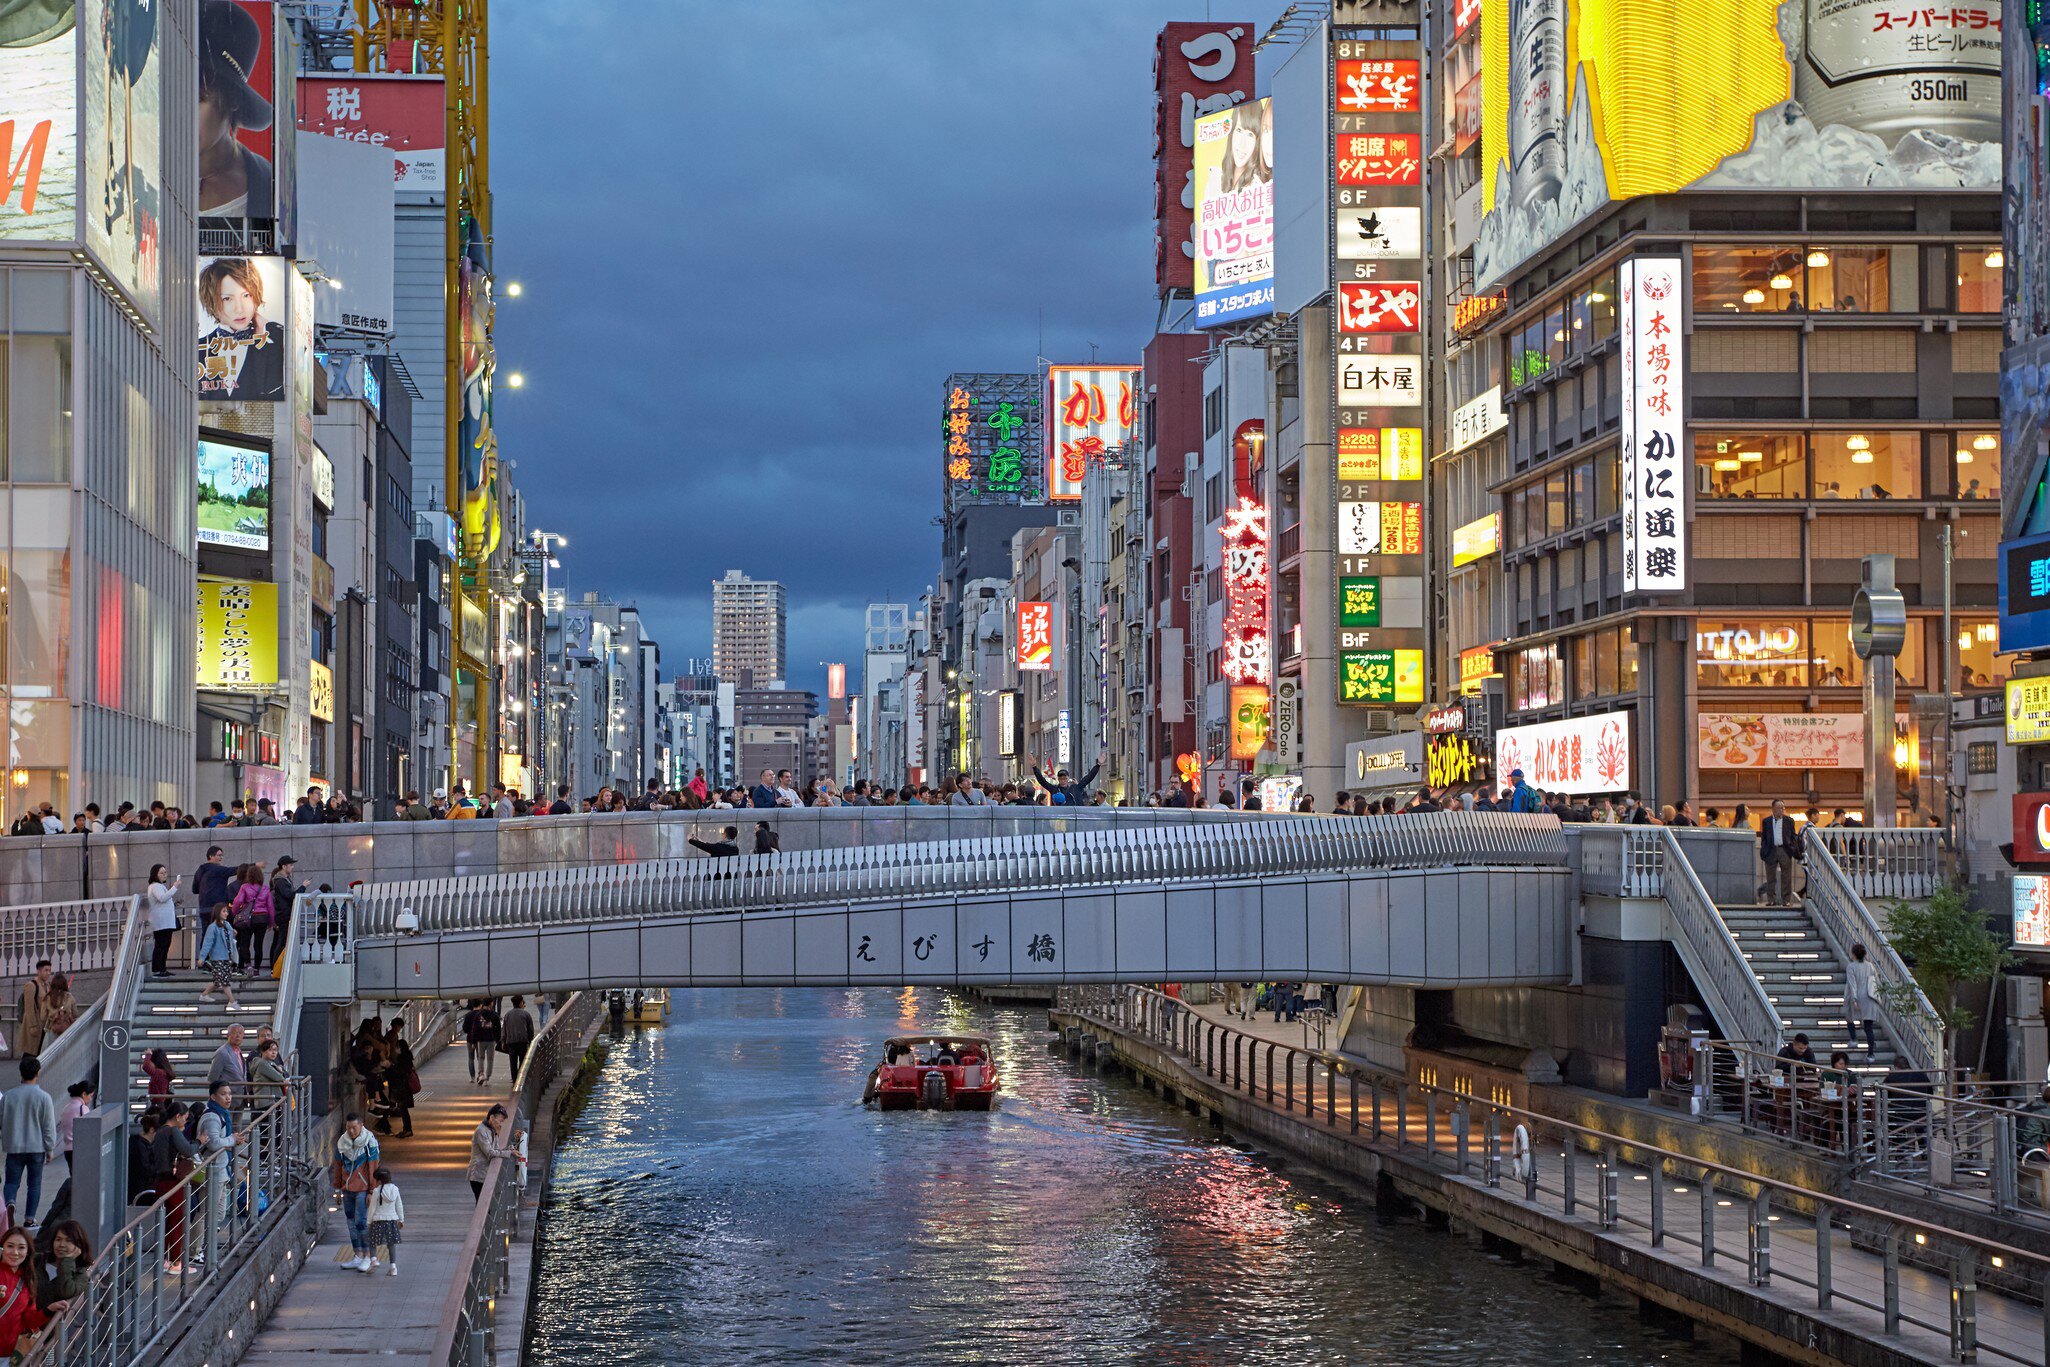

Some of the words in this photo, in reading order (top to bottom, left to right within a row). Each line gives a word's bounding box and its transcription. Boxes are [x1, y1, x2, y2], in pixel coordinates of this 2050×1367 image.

[1360, 62, 1395, 74] 居楽屋
[1910, 79, 1968, 101] 350ml
[326, 87, 362, 121] 税
[1349, 136, 1386, 157] 相席
[1338, 158, 1420, 181] ダイニング
[1217, 259, 1254, 279] いちごナビ
[1354, 264, 1377, 278] 5F
[1341, 288, 1418, 329] はや
[341, 313, 388, 331] 意匠作成中
[1645, 310, 1672, 417] 本場の味
[1343, 363, 1415, 390] 白木屋
[949, 388, 972, 480] お好み焼
[1461, 402, 1488, 445] 白木屋
[987, 401, 1024, 483] 千房
[231, 452, 267, 489] 爽快
[1217, 496, 1268, 684] 大阪王将
[1346, 590, 1374, 603] びっくり
[1344, 601, 1376, 614] ドンキー
[1020, 612, 1035, 654] ドラッグ
[1033, 605, 1048, 645] ツルハ
[1342, 632, 1370, 647] B1F
[1346, 662, 1390, 682] びっくり
[1344, 680, 1392, 699] ドンキー
[1783, 717, 1839, 727] 特別会席フェア
[856, 933, 1057, 963] えびす橋
